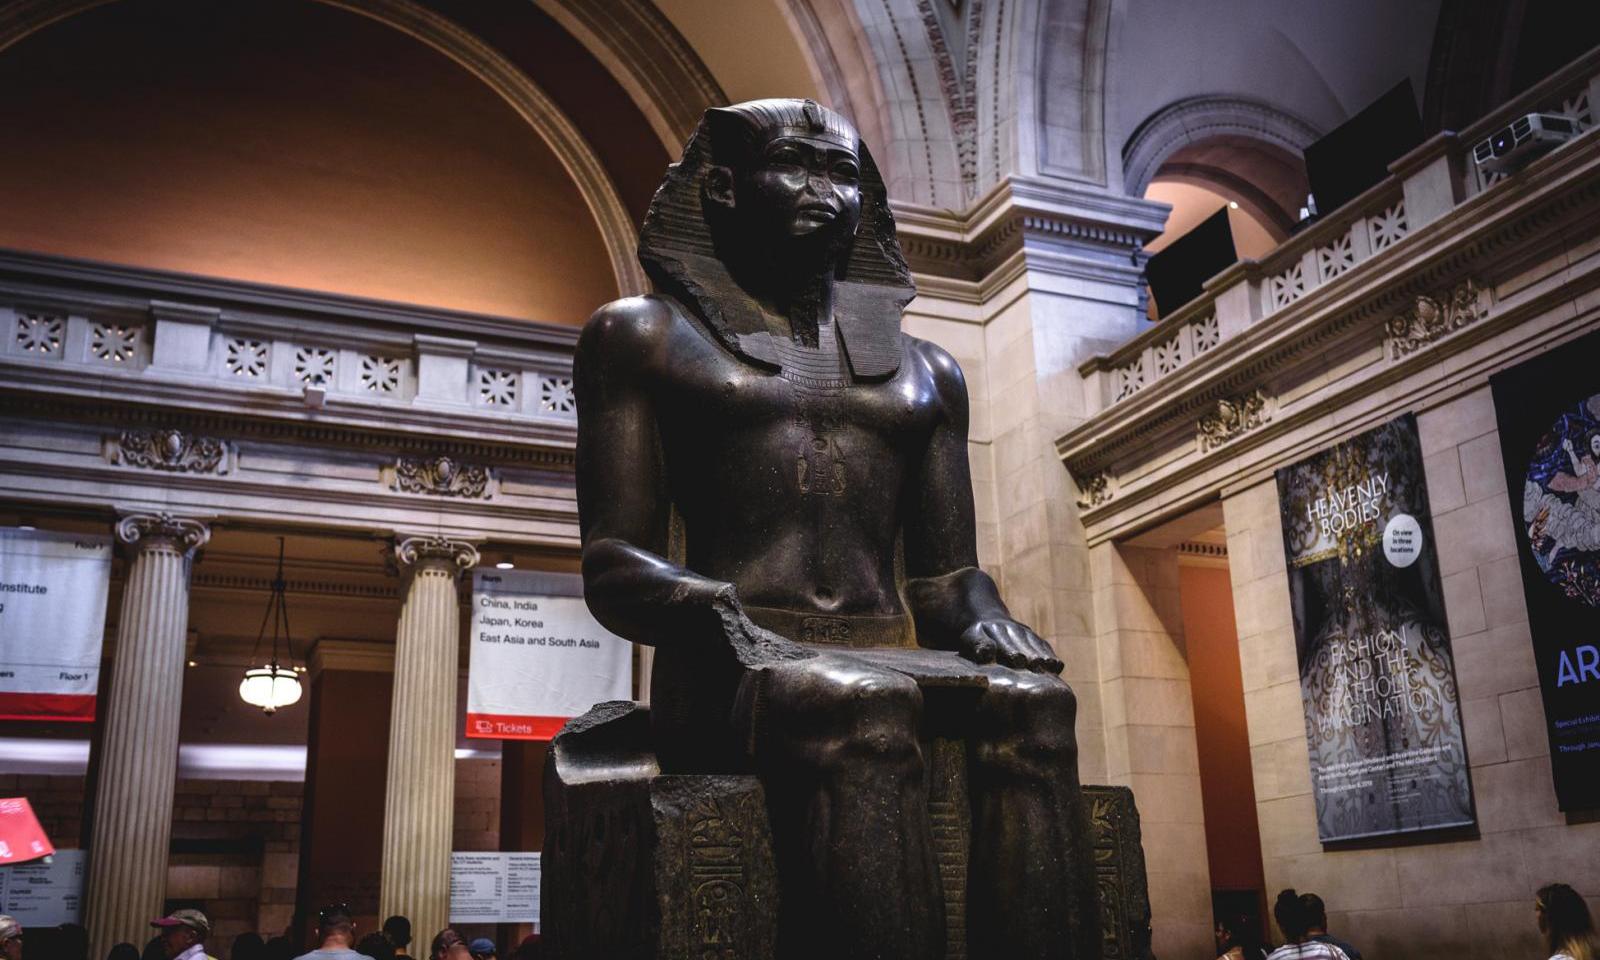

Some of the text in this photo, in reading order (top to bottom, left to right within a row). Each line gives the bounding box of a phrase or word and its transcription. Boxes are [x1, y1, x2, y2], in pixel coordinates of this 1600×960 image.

[1307, 472, 1388, 522] HEAVENLY
[1321, 498, 1380, 538] BODIES
[0, 582, 48, 595] Institute
[480, 597, 538, 611] China, India
[479, 617, 544, 629] Japan, Korea
[479, 632, 600, 649] East Asia and South Asia
[1330, 626, 1407, 667] FASHION
[59, 671, 82, 681] Floor
[84, 672, 89, 681] 1
[1333, 647, 1410, 688] AND THE
[1329, 668, 1420, 709] CATHOLIC
[1316, 688, 1442, 733] IMAGINATION
[496, 722, 533, 734] Tickets
